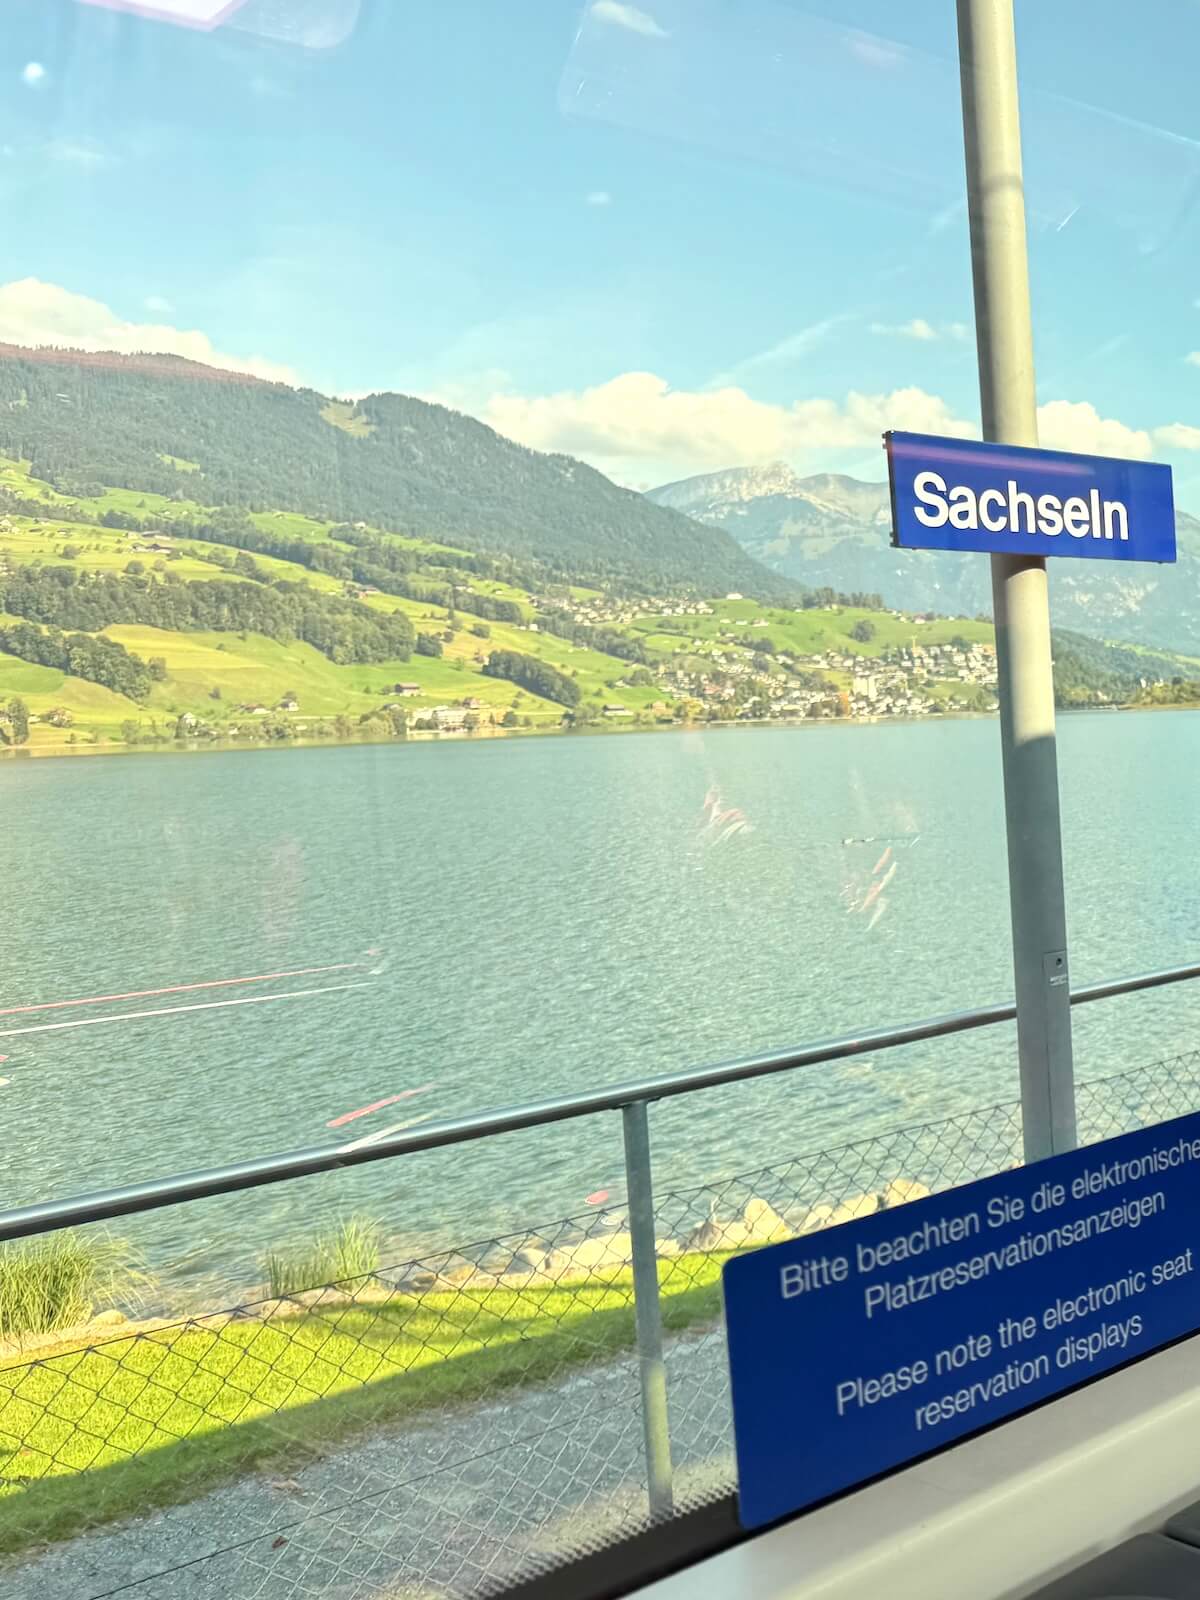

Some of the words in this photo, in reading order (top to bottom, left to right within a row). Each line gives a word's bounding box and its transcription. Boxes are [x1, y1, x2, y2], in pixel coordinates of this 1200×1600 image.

[912, 471, 1130, 540] Sachseln
[780, 1257, 849, 1299] Bitte
[857, 1213, 980, 1272] beachten
[987, 1198, 1025, 1228] Sie
[1031, 1183, 1066, 1213] die
[865, 1191, 1166, 1318] Platzreservationsanzeigen
[837, 1360, 929, 1416] Please
[935, 1334, 993, 1375] note
[998, 1316, 1038, 1349] the
[1043, 1271, 1147, 1330] electronic
[1152, 1248, 1194, 1286] seat
[915, 1355, 1050, 1431] reservation
[1055, 1315, 1143, 1369] displays
